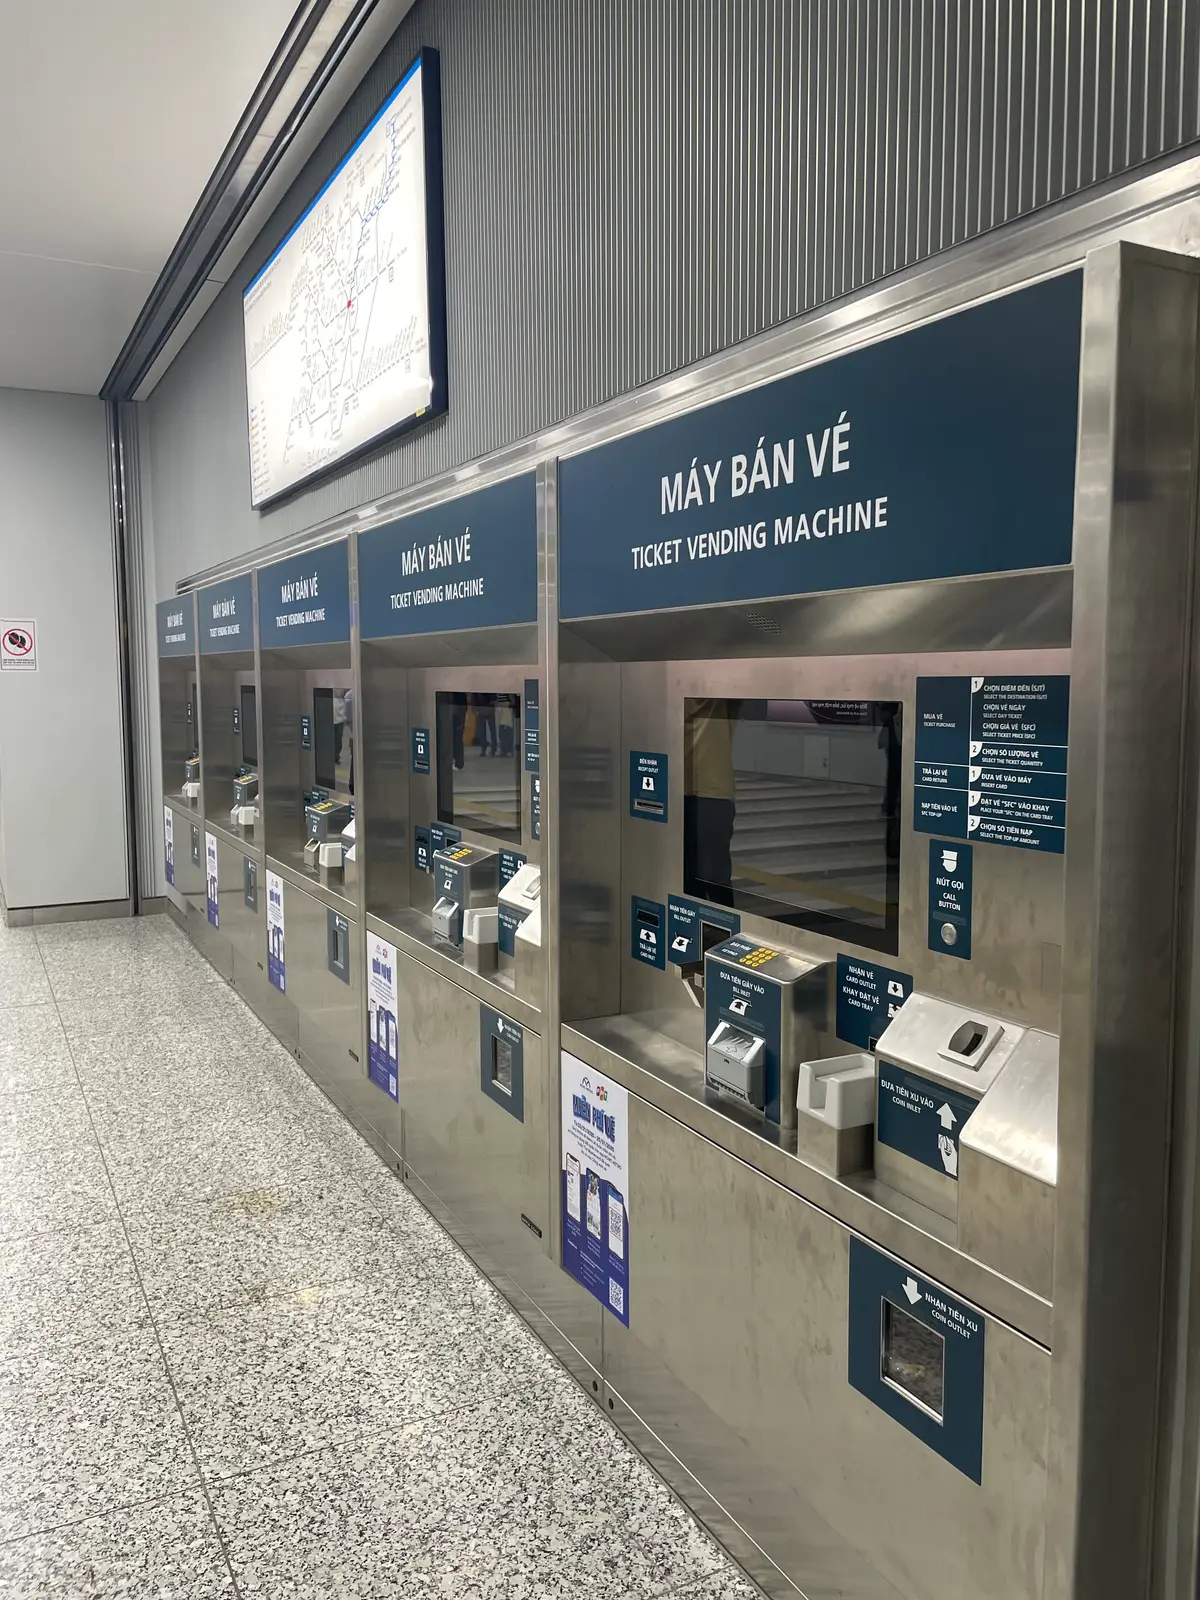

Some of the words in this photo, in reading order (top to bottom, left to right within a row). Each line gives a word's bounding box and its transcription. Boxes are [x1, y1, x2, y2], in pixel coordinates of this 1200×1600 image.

[661, 457, 722, 514] MÁY
[732, 436, 794, 497] BÁN
[806, 411, 850, 478] VÉ
[632, 539, 682, 569] TICKET
[687, 522, 766, 560] VENDING
[775, 497, 887, 545] MACHINE
[402, 543, 425, 576] MÁY
[429, 535, 452, 570] BÁN
[455, 527, 470, 563] VÉ
[282, 580, 294, 603] MÁY
[296, 576, 308, 600] BÁN
[309, 572, 318, 597] VÉ
[391, 592, 411, 609] TICKET
[413, 586, 443, 605] VENDING
[446, 578, 483, 600] MACHINE
[276, 615, 288, 627] TICKET
[288, 612, 304, 625] VENDING
[305, 608, 325, 623] MACHINE
[1031, 750, 1039, 758] VÉ
[1018, 802, 1031, 810] VÀO
[1032, 804, 1050, 812] KHAY
[980, 823, 996, 831] CHỌN
[936, 877, 950, 886] NÚT
[951, 881, 964, 891] GỌI
[939, 900, 960, 911] BUTTON
[943, 893, 956, 901] CALL
[846, 975, 858, 984] CARD
[859, 980, 876, 990] OUTLET
[849, 966, 865, 976] NHẬN
[866, 971, 874, 980] VÉ
[720, 972, 730, 981] ĐƯA
[754, 984, 764, 994] VÀO
[740, 989, 751, 997] INLET
[843, 986, 858, 996] KHAY
[872, 996, 880, 1005] VÉ
[848, 998, 860, 1007] CARD
[861, 1003, 873, 1012] TRAY
[881, 1080, 895, 1092] ĐƯA
[910, 1091, 919, 1102] XU
[920, 1096, 934, 1109] VÀO
[892, 1096, 906, 1107] COIN
[906, 1103, 921, 1114] INLET
[604, 1114, 616, 1144] VÉ
[925, 1292, 946, 1312] NHẬN
[967, 1318, 978, 1332] XU
[932, 1310, 946, 1324] COIN
[948, 1319, 970, 1339] OUTLET
